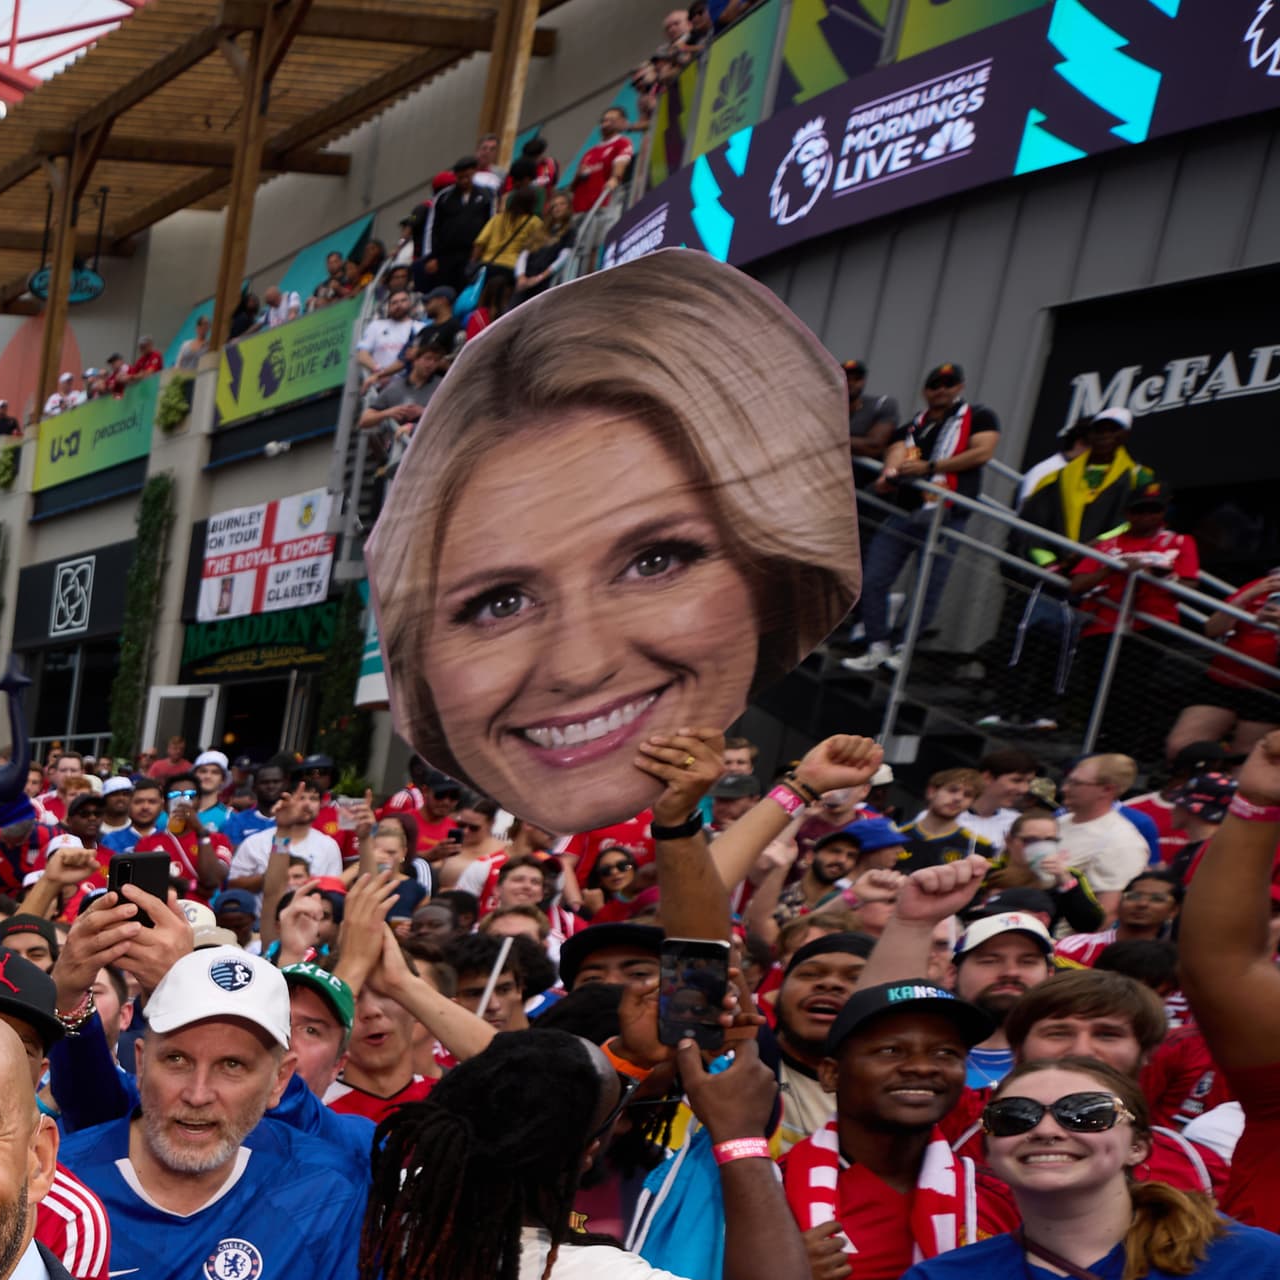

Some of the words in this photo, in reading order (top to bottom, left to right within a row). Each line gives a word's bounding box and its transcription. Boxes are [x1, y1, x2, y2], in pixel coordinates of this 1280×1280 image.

[846, 94, 919, 130] PREMIER
[924, 66, 992, 101] LEAGUE
[841, 86, 987, 155] MORNINGS
[833, 134, 916, 190] LIVE
[288, 355, 319, 381] LIVE
[209, 511, 265, 534] BURNLEY
[208, 537, 225, 550] ON
[230, 527, 260, 546] TOUR
[207, 556, 232, 575] THE
[234, 547, 277, 570] ROYAL
[281, 536, 332, 561] DYCHE
[296, 562, 321, 580] THE
[267, 581, 324, 602] CLARETS
[888, 984, 957, 1002] KANSA
[217, 1241, 254, 1255] CHELSEA
